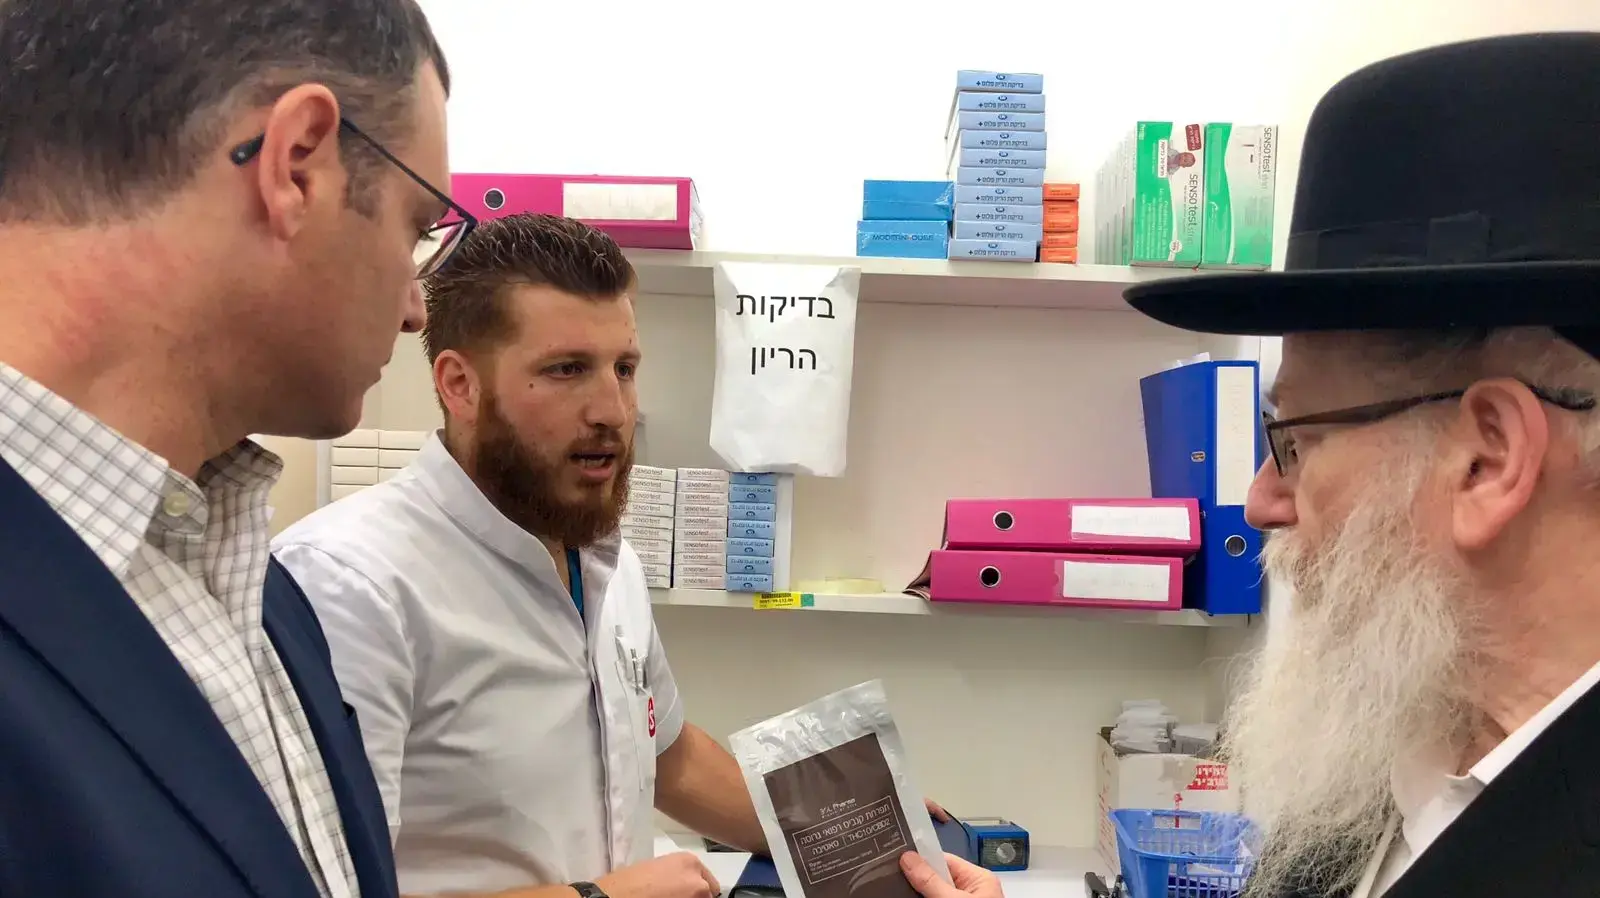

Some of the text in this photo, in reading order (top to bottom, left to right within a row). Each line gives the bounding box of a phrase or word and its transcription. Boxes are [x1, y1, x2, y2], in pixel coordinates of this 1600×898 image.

[736, 294, 835, 323] בדיקות
[752, 347, 817, 375] הריון
[822, 824, 842, 836] רפואי
[843, 815, 864, 829] קנביס
[848, 819, 891, 842] THC10/CBD2
[812, 840, 840, 855] סאטיבה
